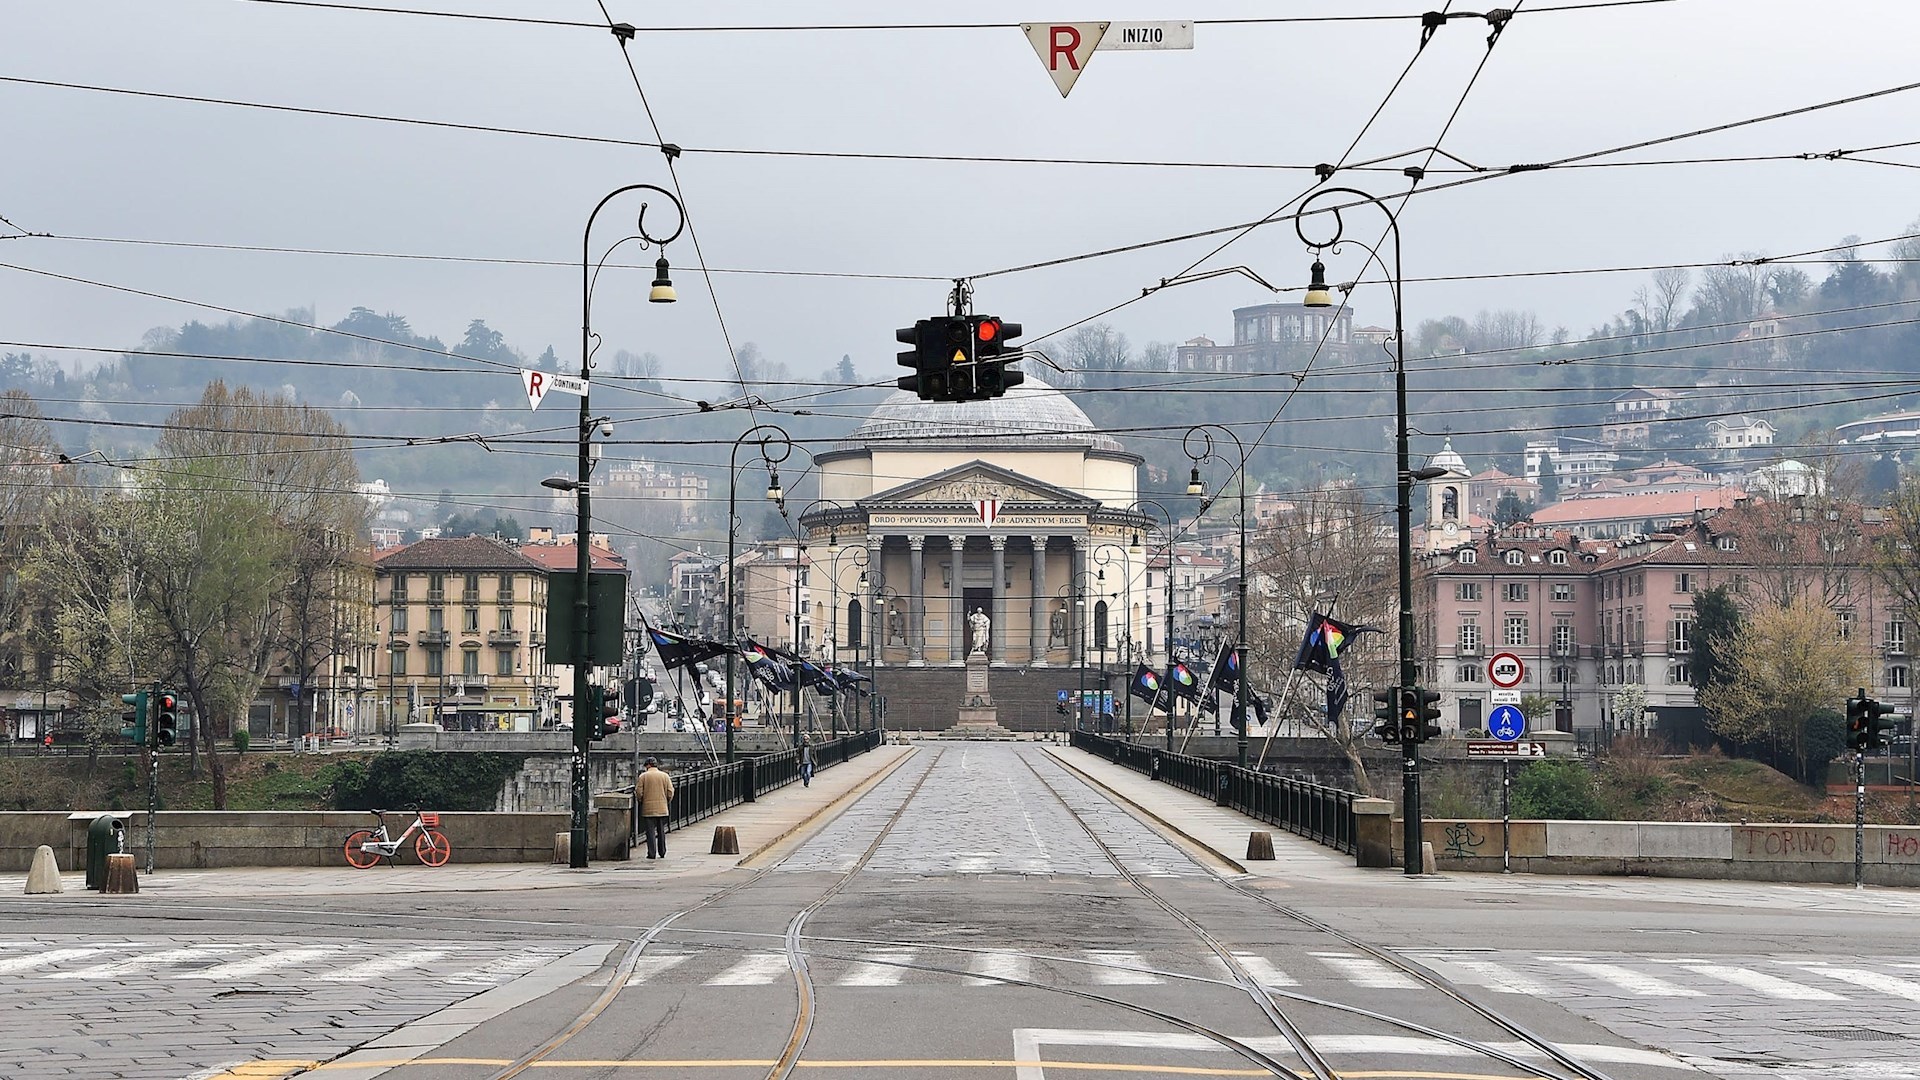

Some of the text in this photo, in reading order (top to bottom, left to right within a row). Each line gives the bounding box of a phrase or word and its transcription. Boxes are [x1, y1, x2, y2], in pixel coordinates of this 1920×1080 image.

[1049, 25, 1163, 71] R INIZIO
[529, 372, 582, 397] R CONTINUA
[1740, 829, 1836, 856] TORINO
